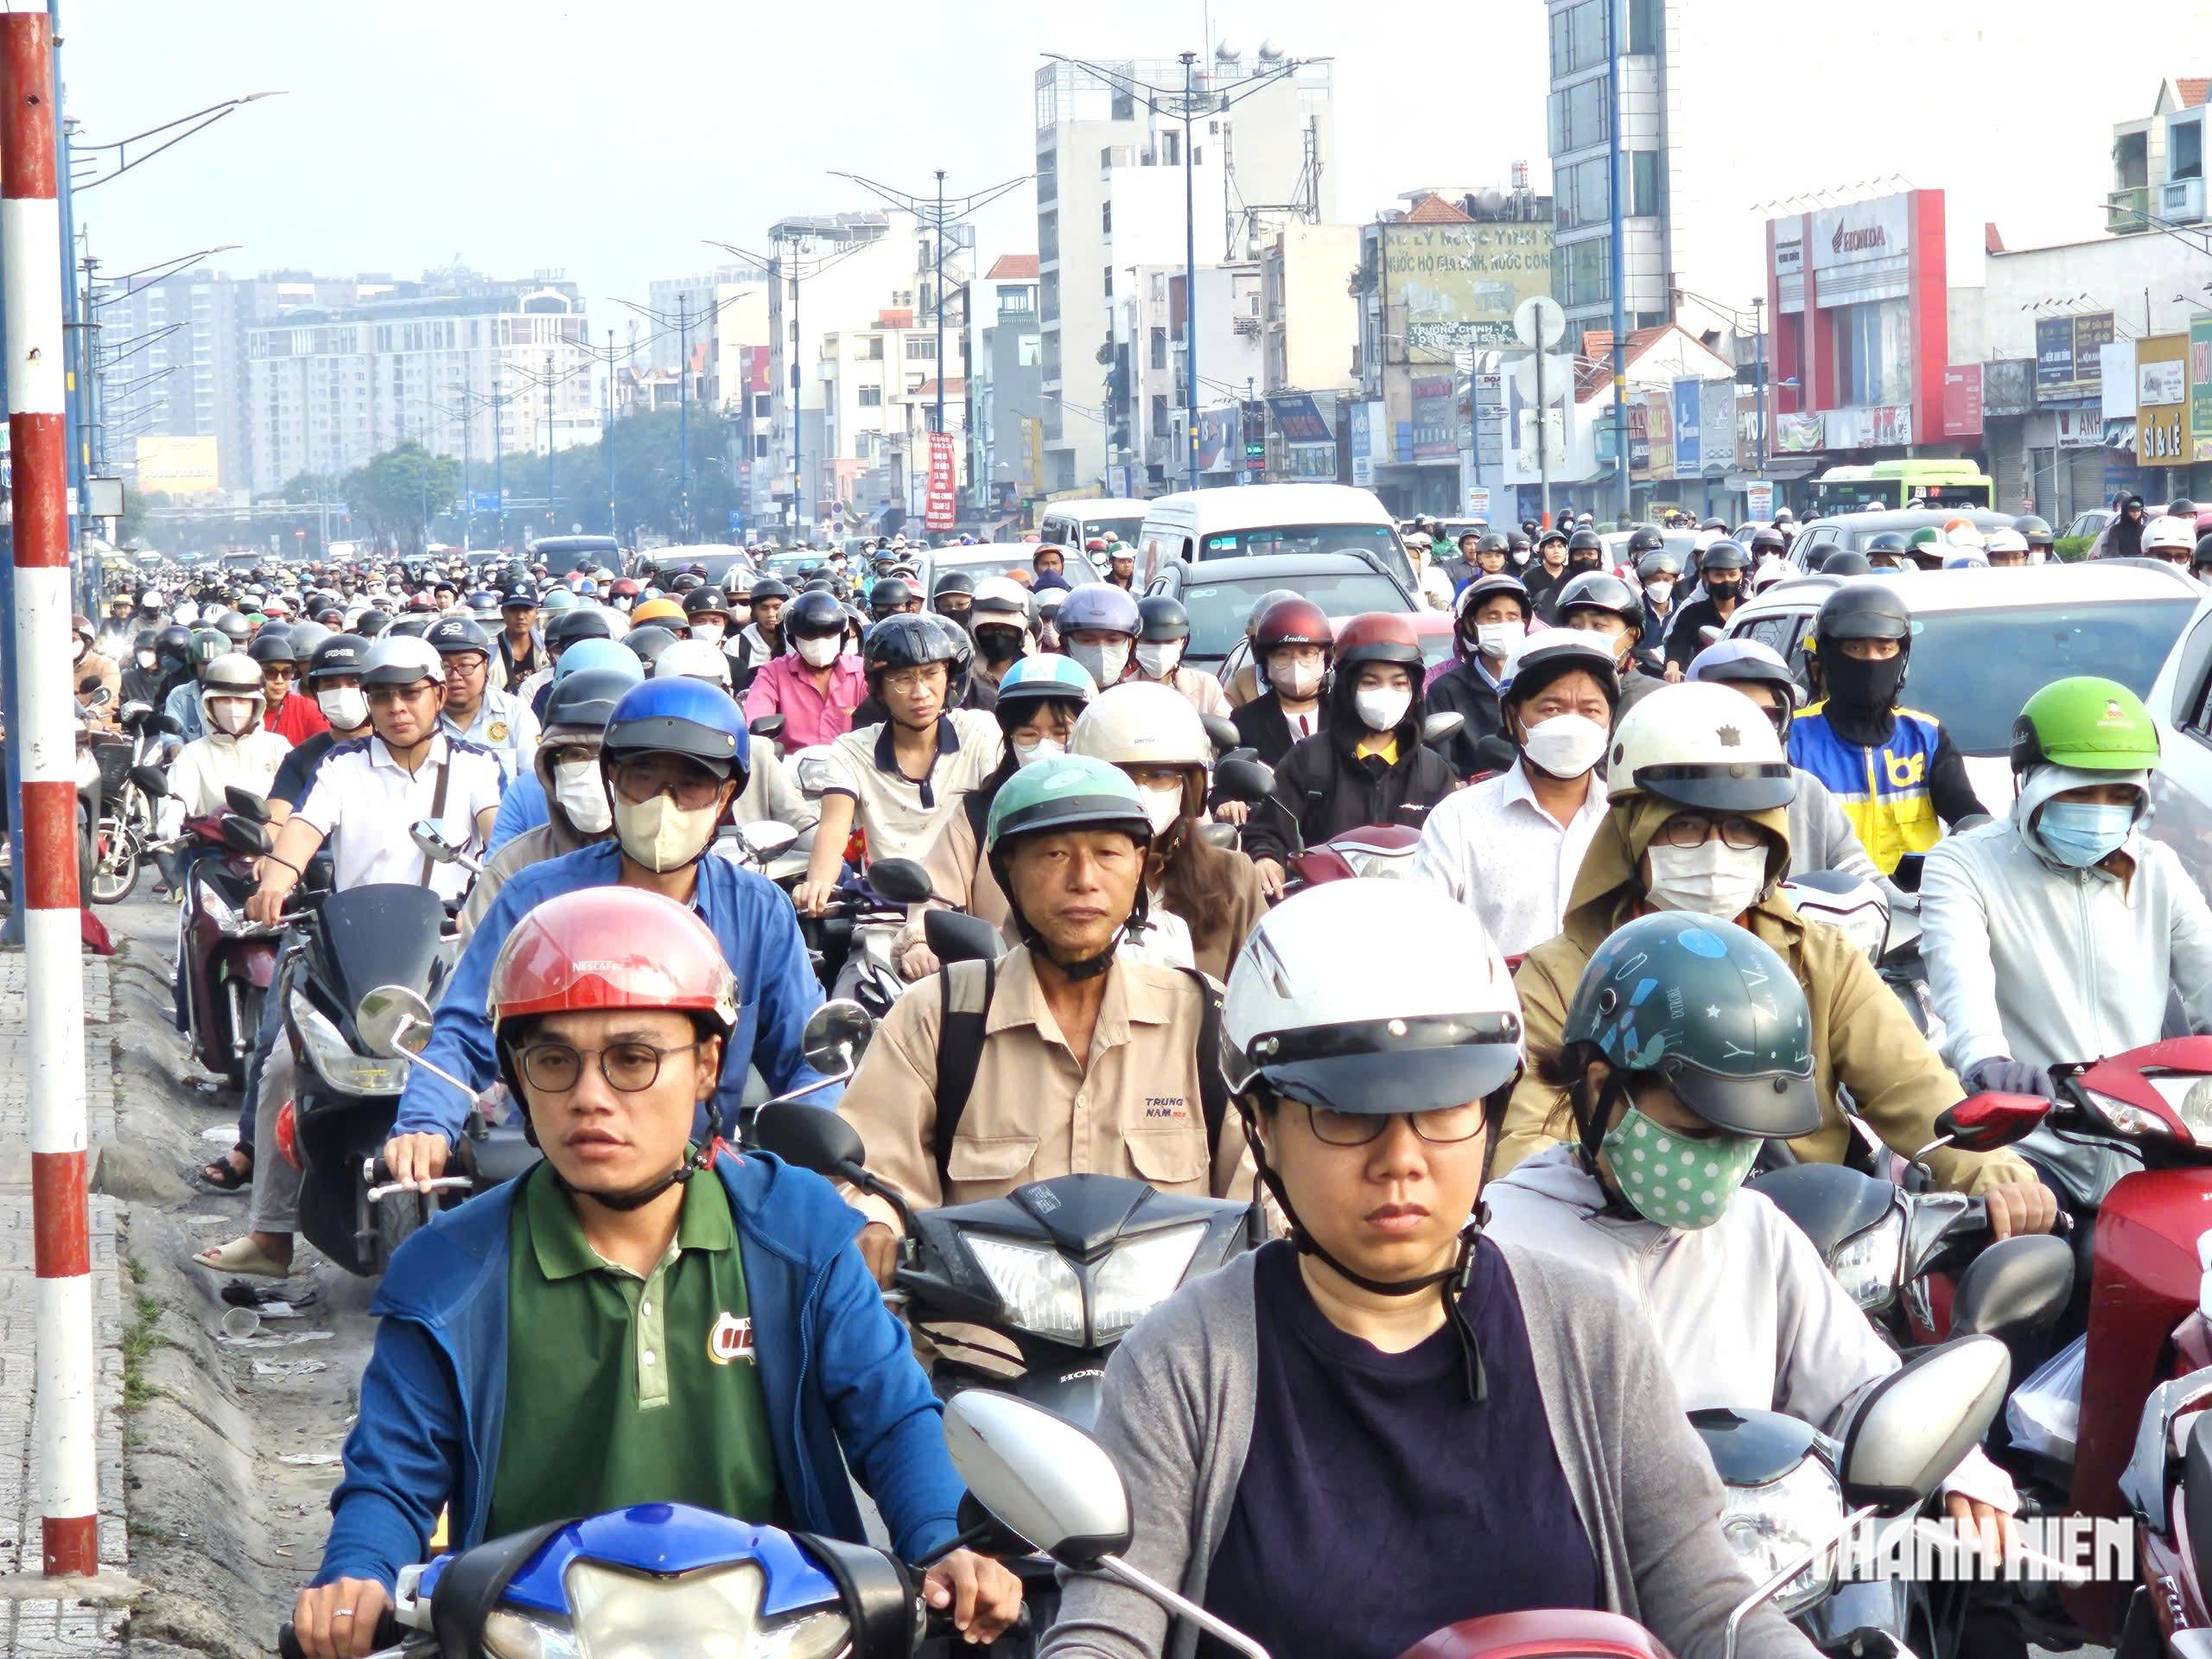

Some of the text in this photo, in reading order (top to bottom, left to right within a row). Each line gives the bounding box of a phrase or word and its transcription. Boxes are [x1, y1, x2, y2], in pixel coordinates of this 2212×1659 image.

[1843, 226, 1885, 251] HONDA
[2158, 426, 2166, 457] &
[1145, 1098, 1184, 1107] TRUNG
[1145, 1108, 1172, 1118] NAM
